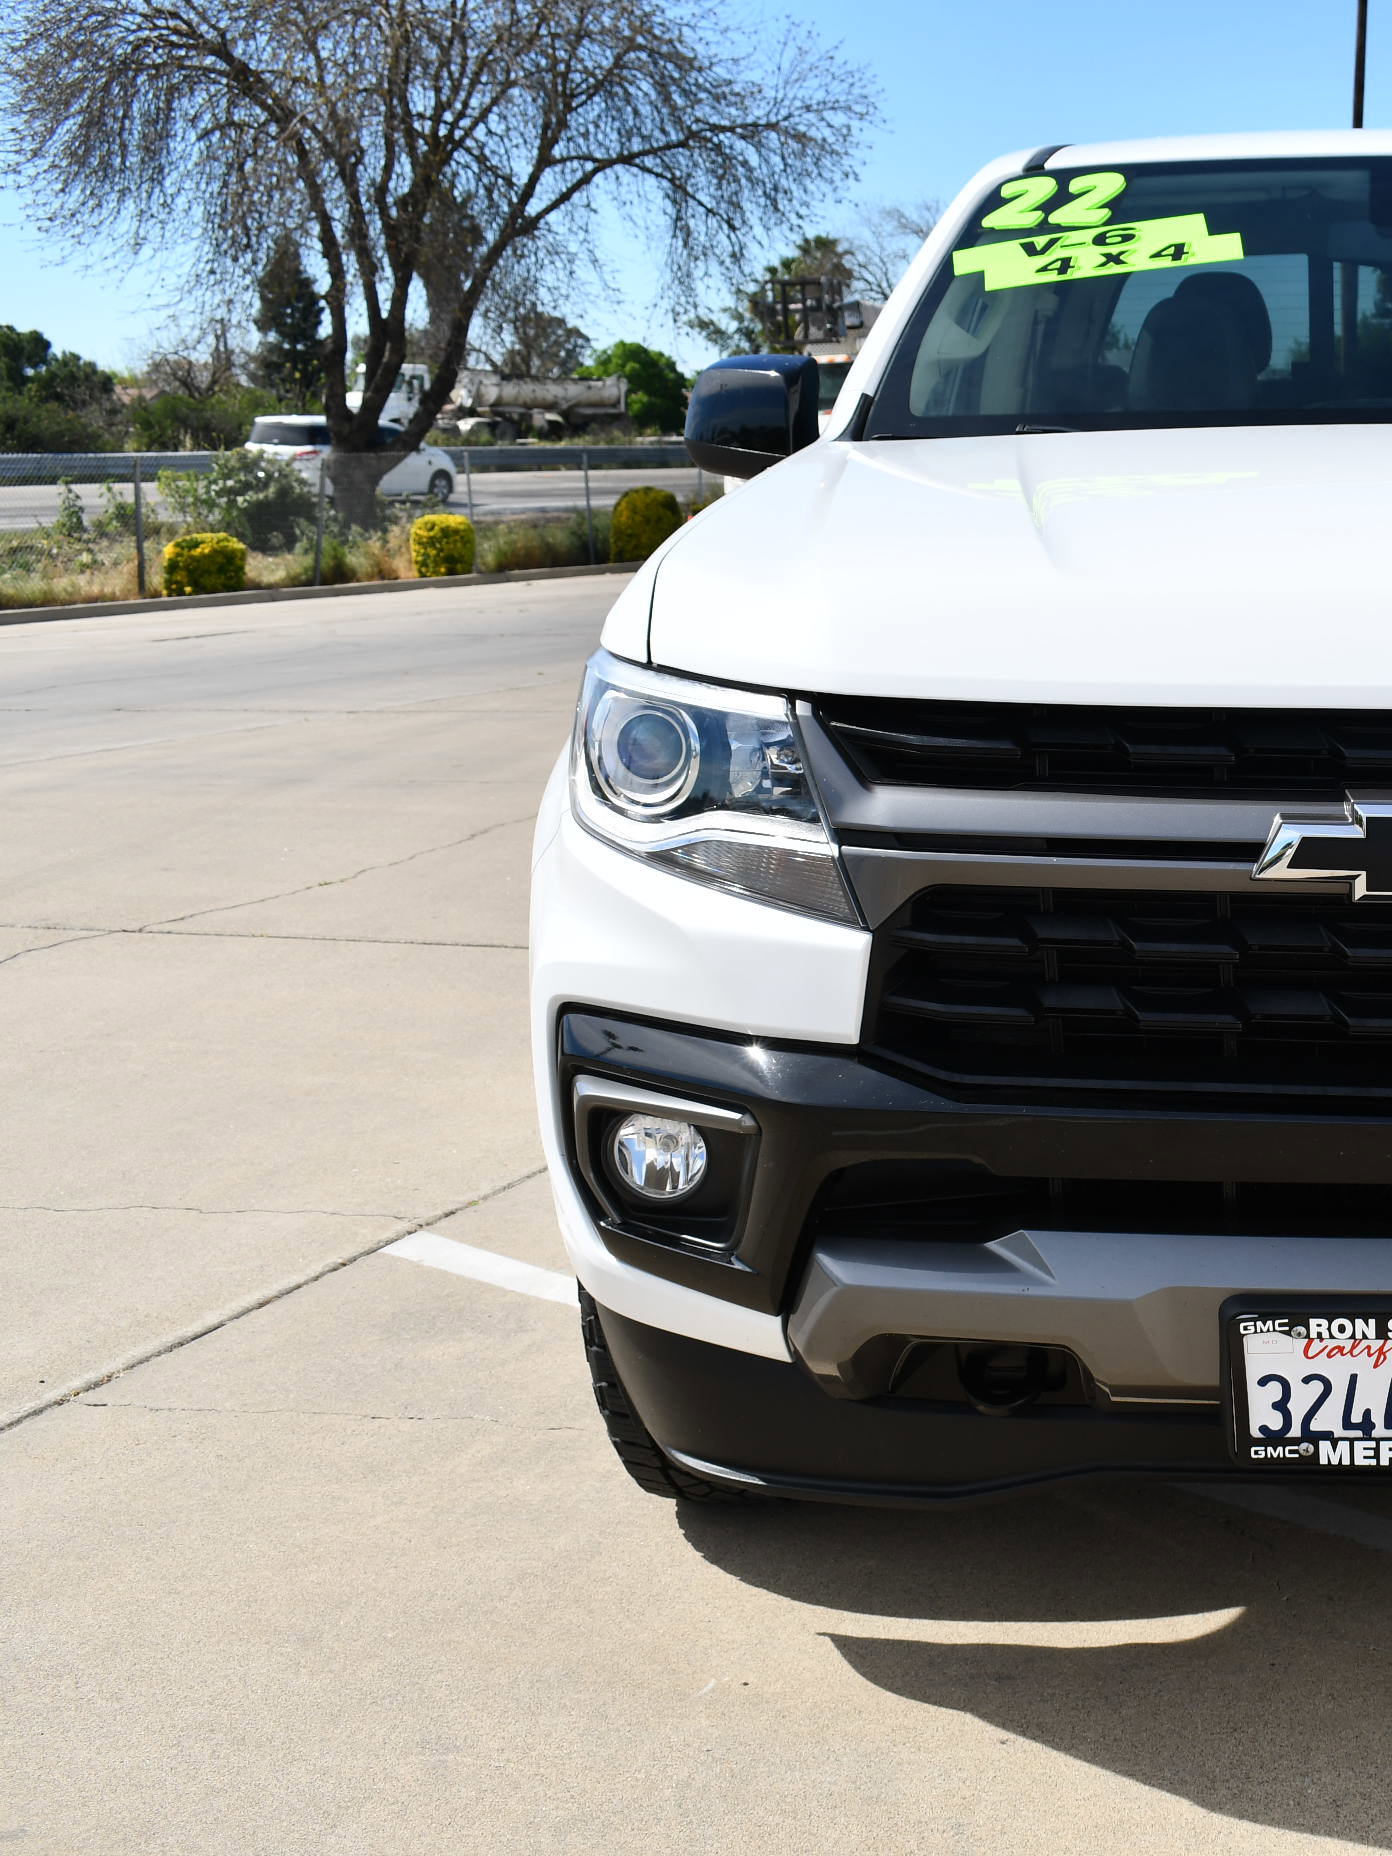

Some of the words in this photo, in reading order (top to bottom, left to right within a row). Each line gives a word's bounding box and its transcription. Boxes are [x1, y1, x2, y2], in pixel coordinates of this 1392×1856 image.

[981, 171, 1127, 230] 22
[1019, 227, 1137, 257] V-6
[1239, 1319, 1290, 1335] GMC
[1309, 1318, 1376, 1339] RON
[1250, 1445, 1300, 1459] GMC
